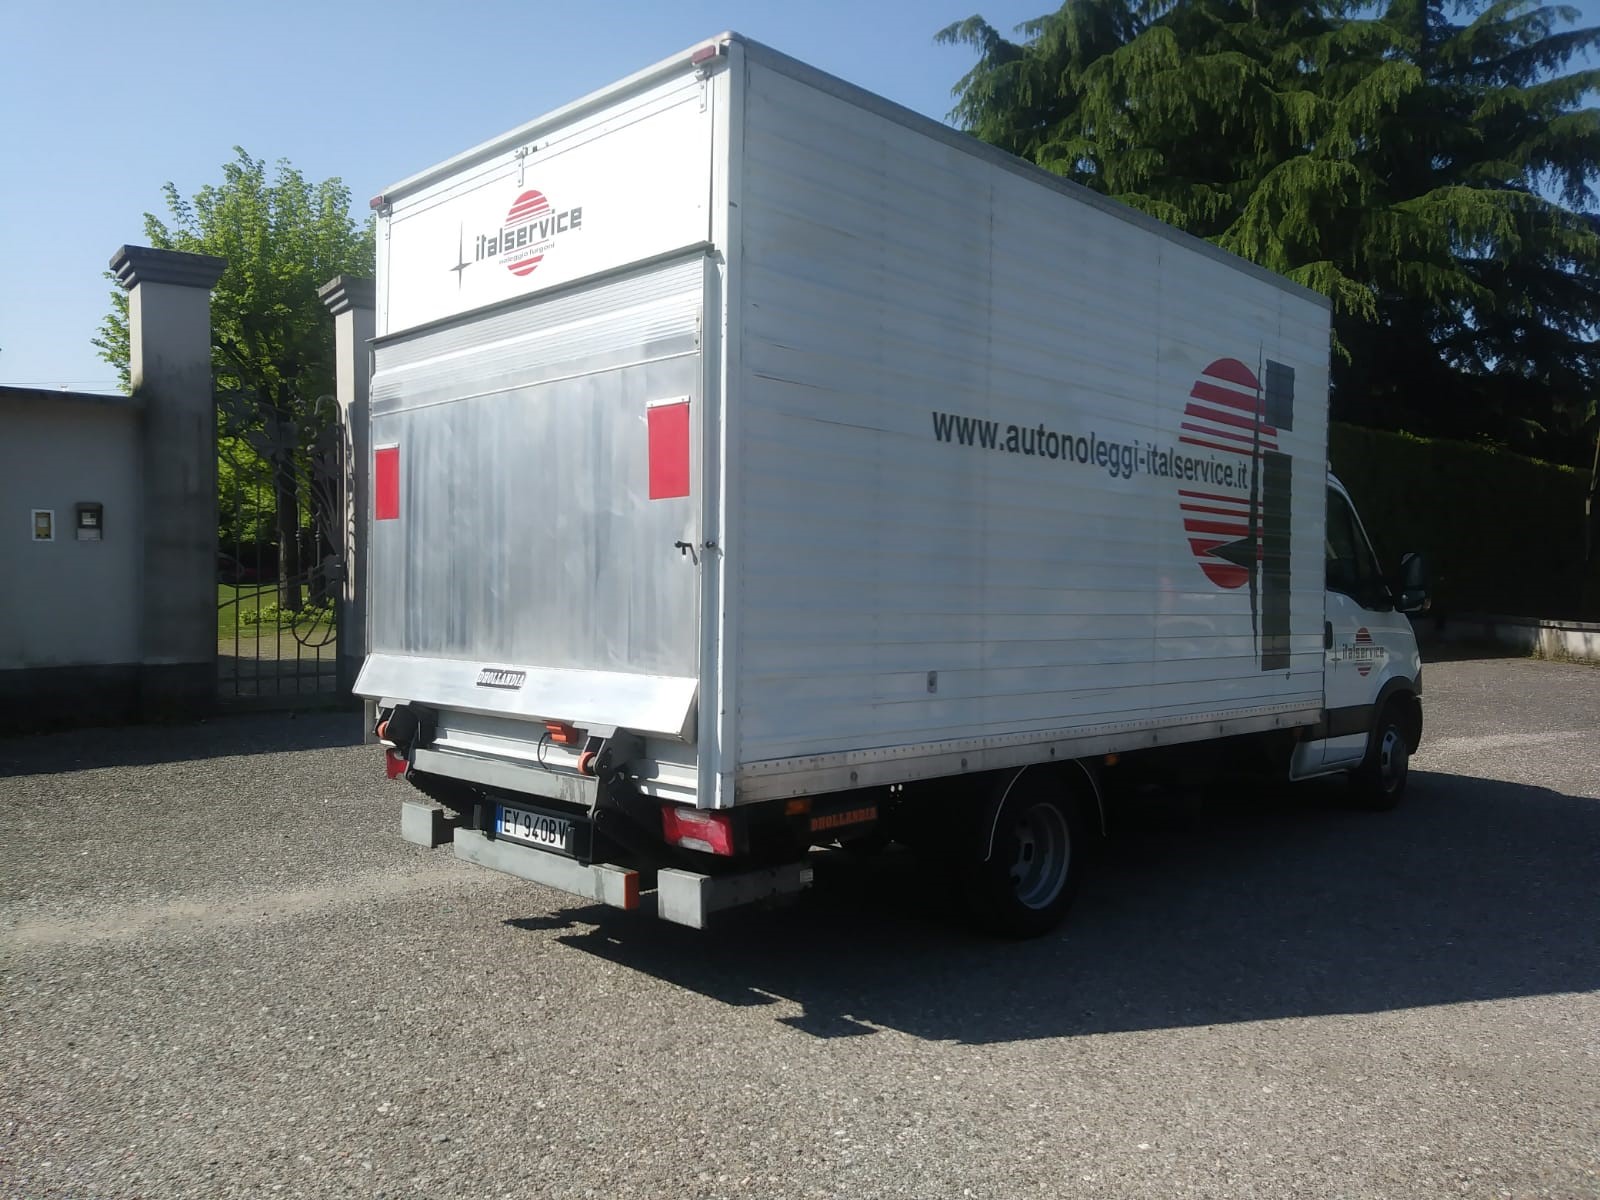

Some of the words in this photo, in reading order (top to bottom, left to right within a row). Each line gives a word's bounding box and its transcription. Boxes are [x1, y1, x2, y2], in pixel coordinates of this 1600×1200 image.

[475, 207, 583, 262] italservice
[932, 411, 1249, 490] www.autonoleggi-italservice.it
[1342, 643, 1385, 660] italservice
[477, 670, 526, 688] DHOLLANDIA
[504, 809, 519, 835] EY
